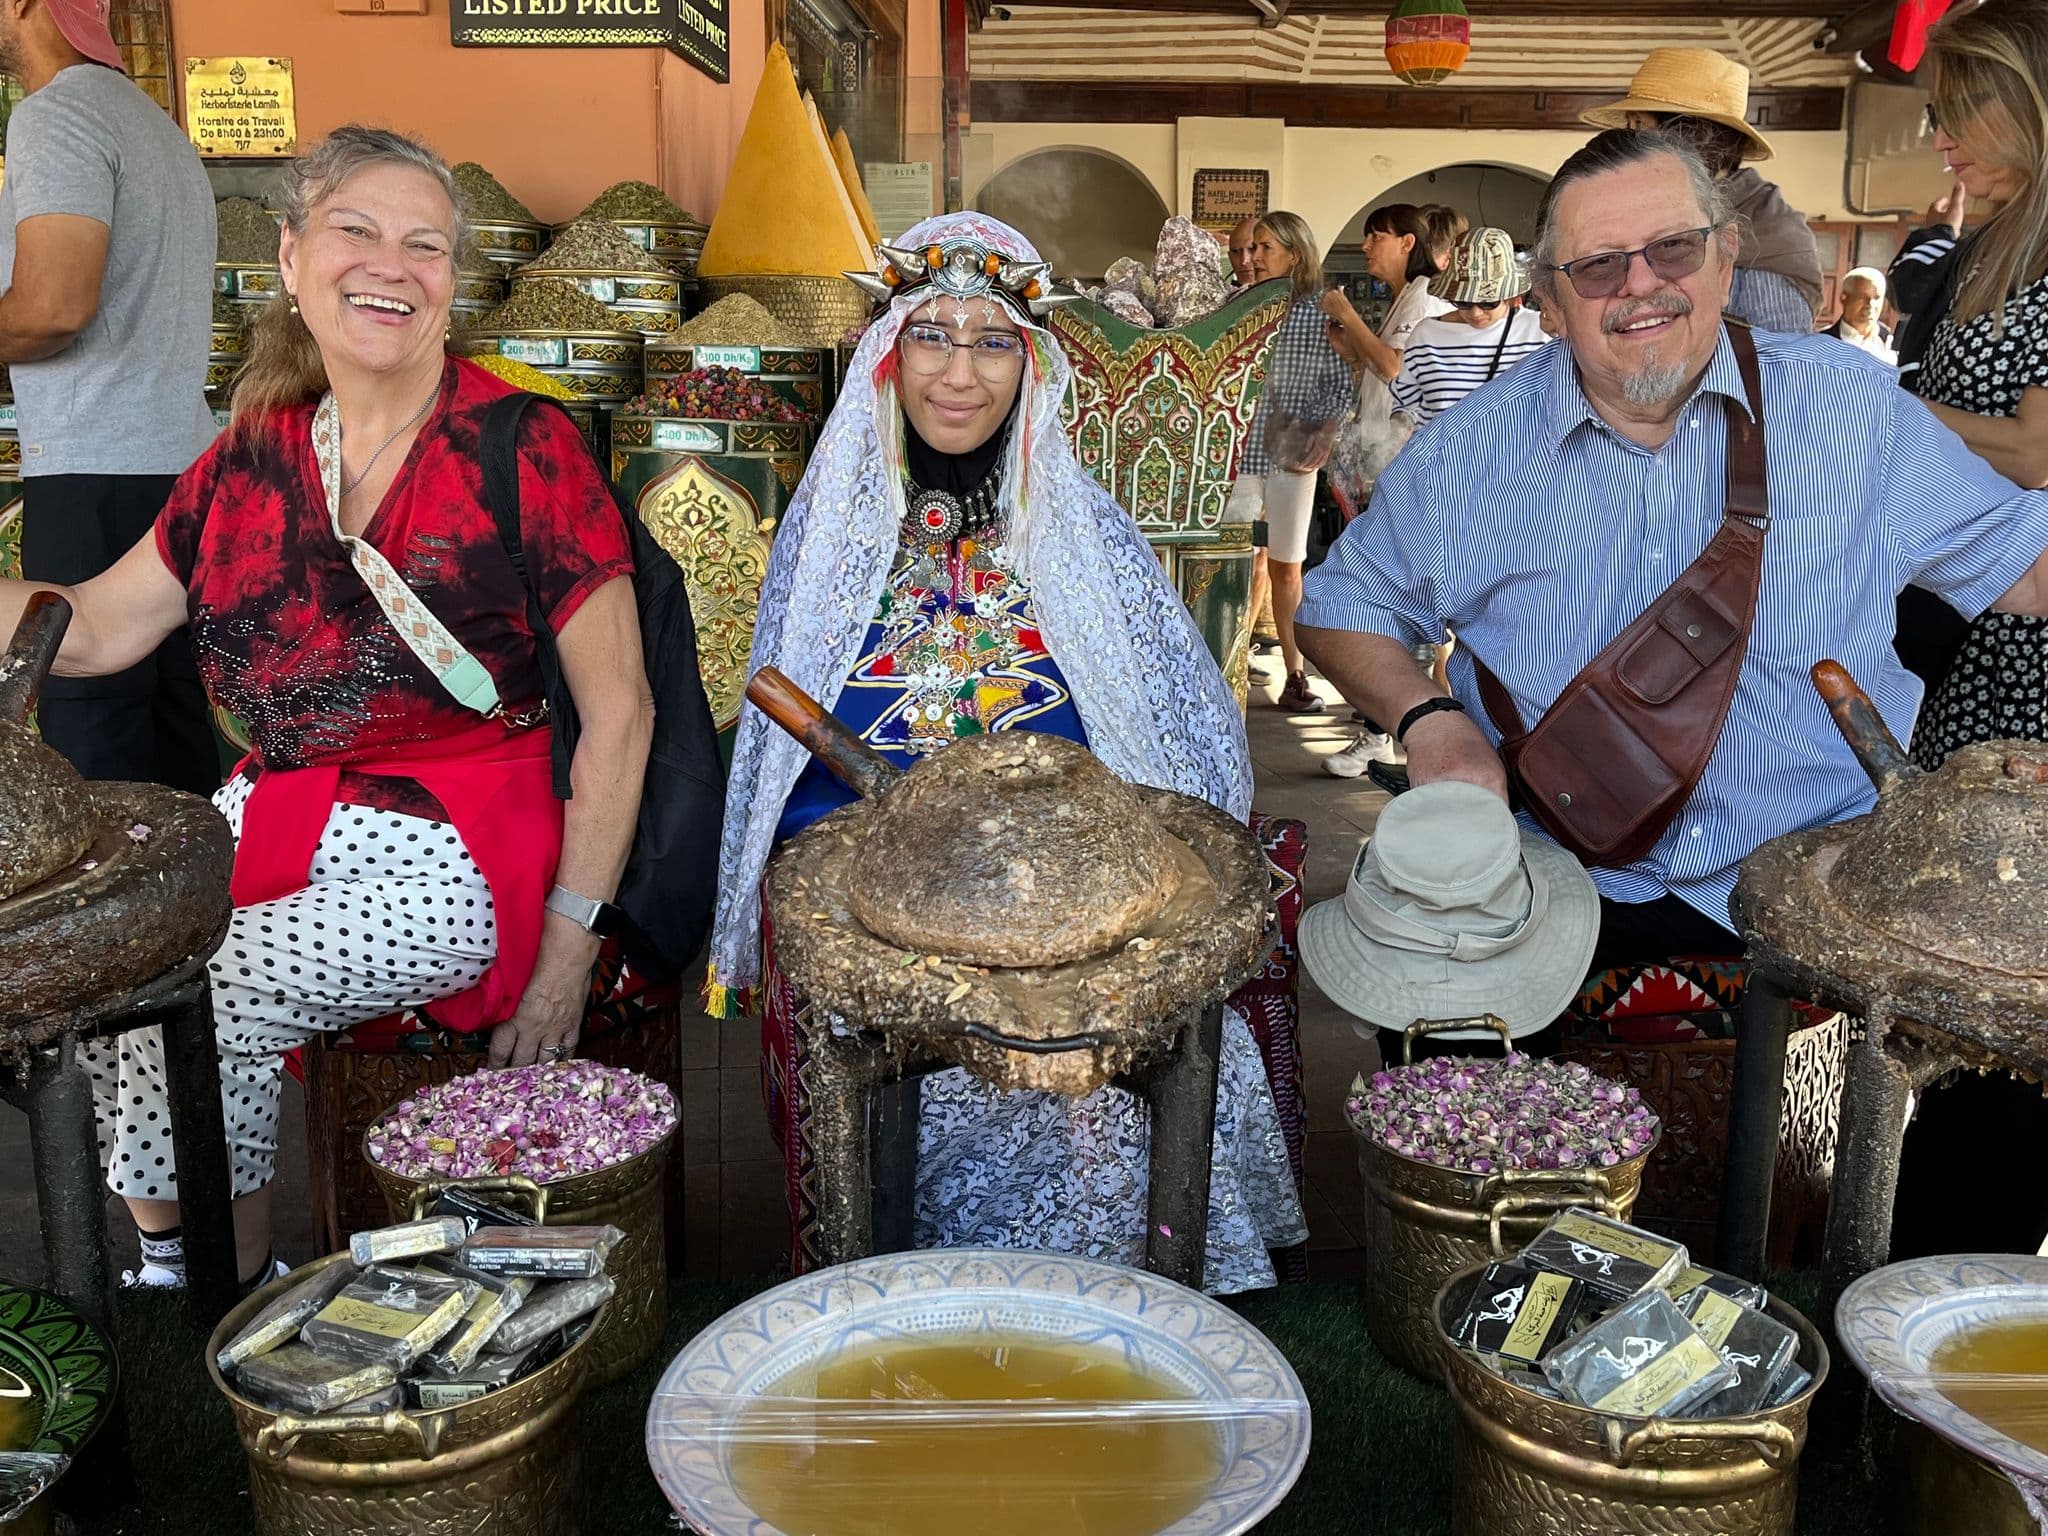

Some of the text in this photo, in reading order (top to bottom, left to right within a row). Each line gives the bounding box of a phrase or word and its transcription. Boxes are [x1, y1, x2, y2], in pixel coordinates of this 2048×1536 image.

[463, 0, 660, 15] LISTED PRICE
[678, 0, 727, 52] LISTED PRICE
[198, 116, 285, 126] Horaire de Travail
[200, 128, 214, 138] De
[217, 128, 242, 138] 8h00
[253, 128, 285, 138] 23h00
[506, 345, 524, 354] 200
